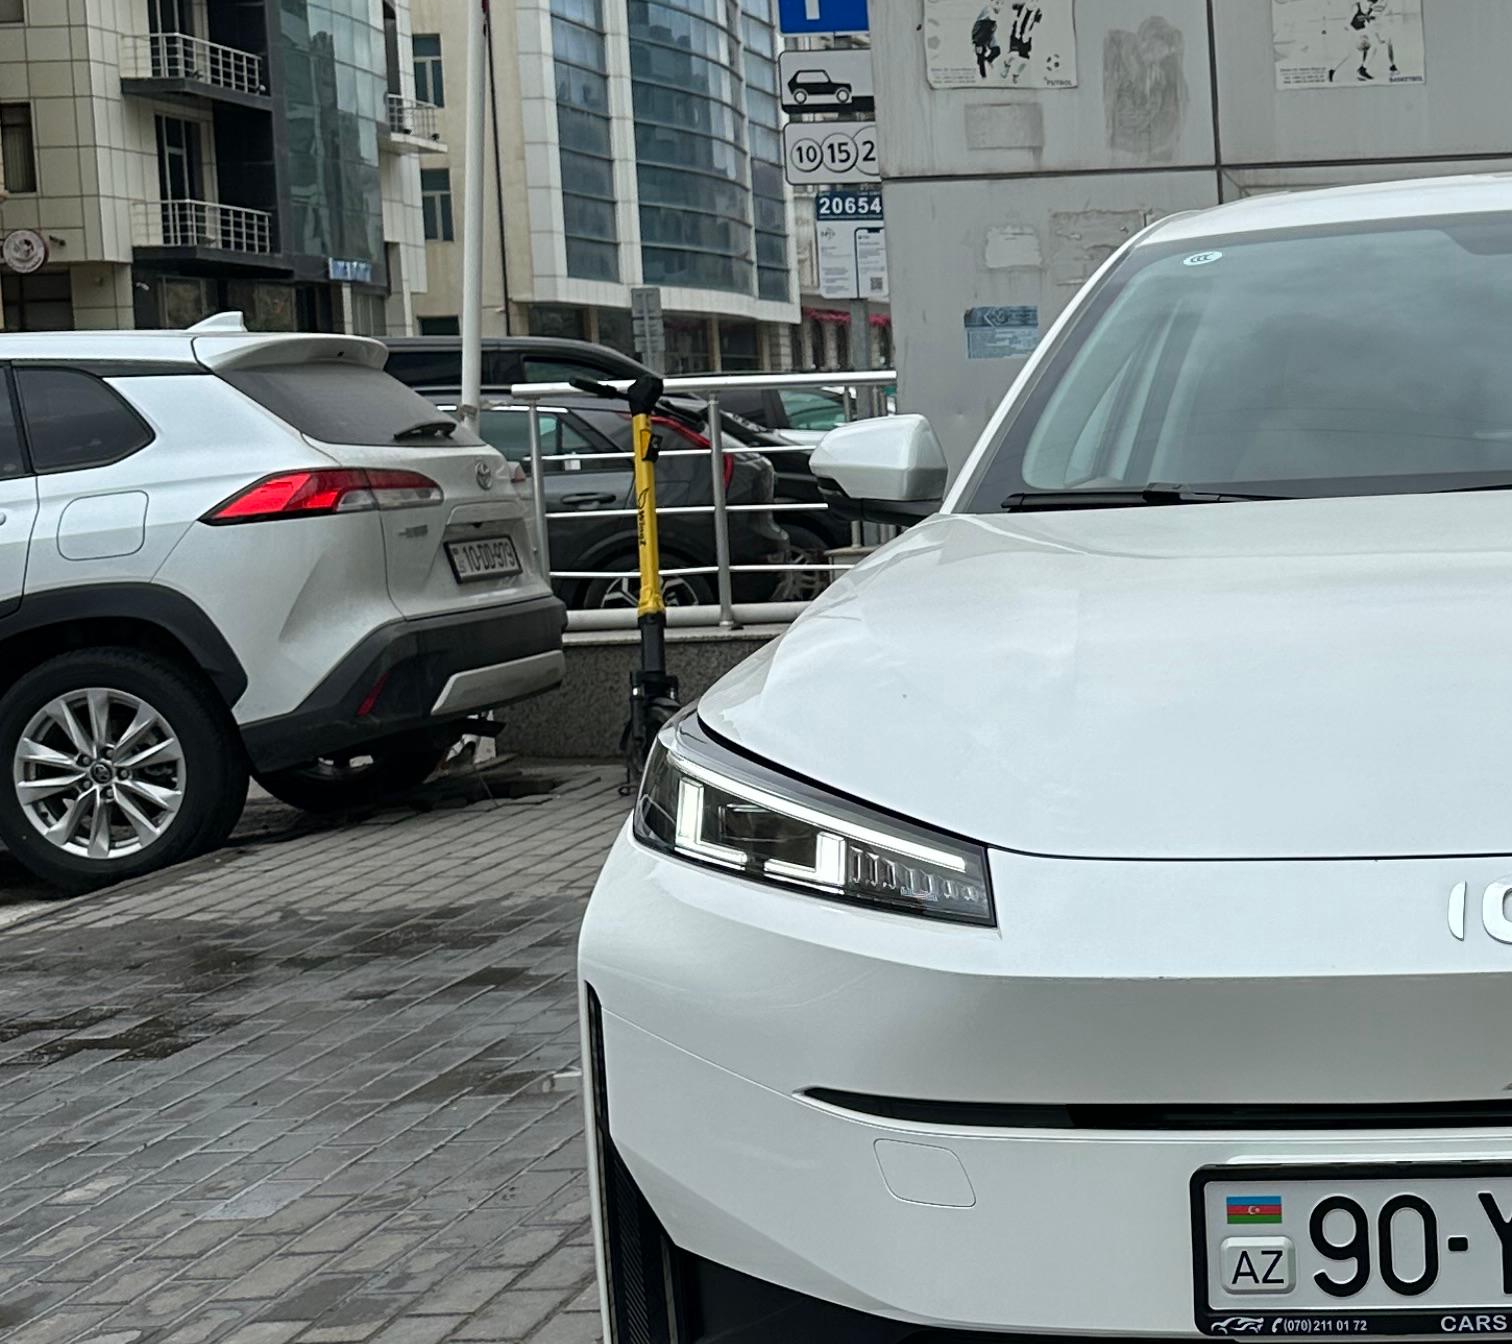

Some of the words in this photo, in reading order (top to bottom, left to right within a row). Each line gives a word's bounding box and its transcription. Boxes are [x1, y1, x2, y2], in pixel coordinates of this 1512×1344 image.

[796, 145, 817, 164] 10
[827, 142, 851, 163] 15
[861, 140, 877, 162] 2
[819, 197, 881, 214] 20654
[1231, 1250, 1285, 1285] AZ
[1283, 1319, 1312, 1333] (070)
[1313, 1320, 1333, 1332] 211
[1336, 1320, 1350, 1332] 01
[1353, 1320, 1368, 1332] 72
[1440, 1315, 1508, 1332] CARS
